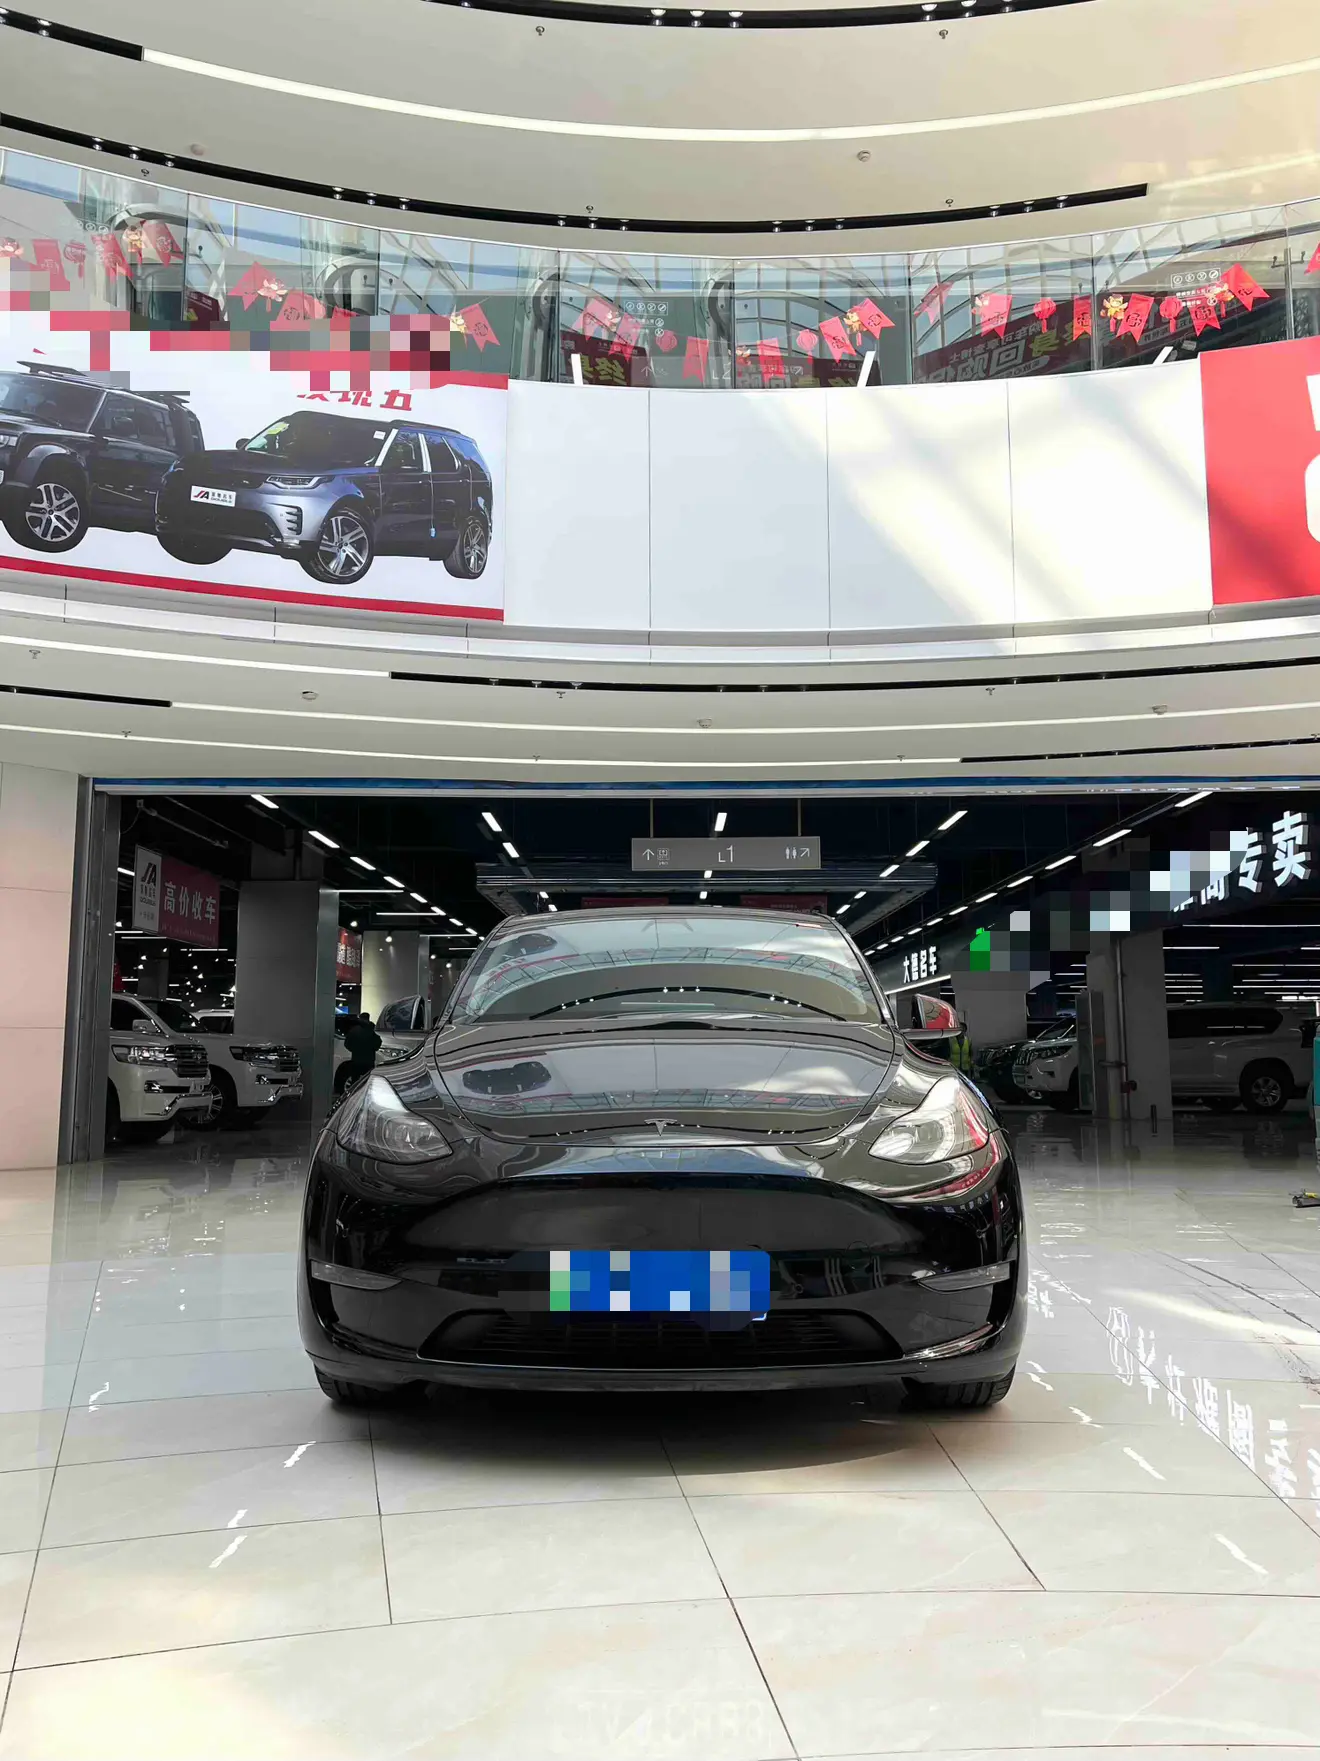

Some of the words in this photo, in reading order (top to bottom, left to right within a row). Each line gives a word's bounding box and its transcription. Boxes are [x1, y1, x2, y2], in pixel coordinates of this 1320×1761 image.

[717, 844, 735, 864] L1
[163, 880, 217, 925] 高价收车
